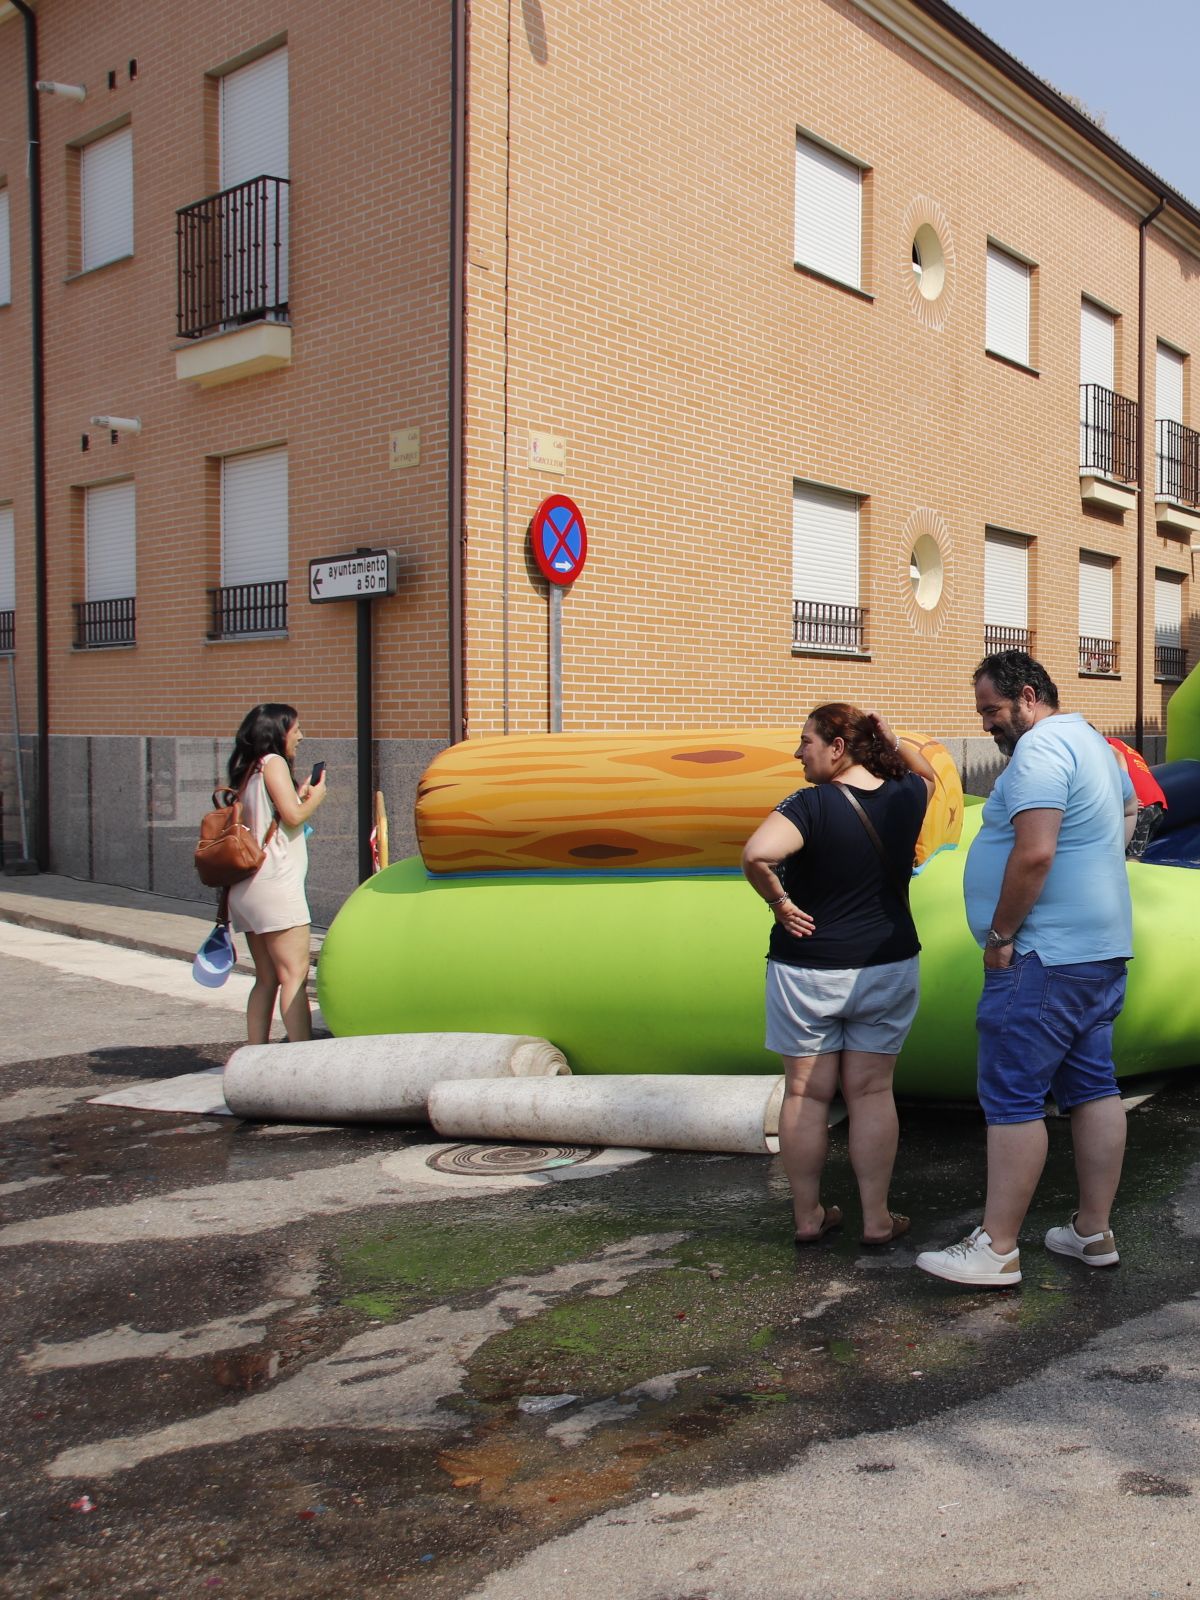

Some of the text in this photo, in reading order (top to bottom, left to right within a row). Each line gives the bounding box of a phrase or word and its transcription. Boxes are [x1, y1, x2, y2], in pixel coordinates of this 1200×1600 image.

[328, 558, 386, 579] ayuntamiento
[357, 575, 386, 590] a 50 m
